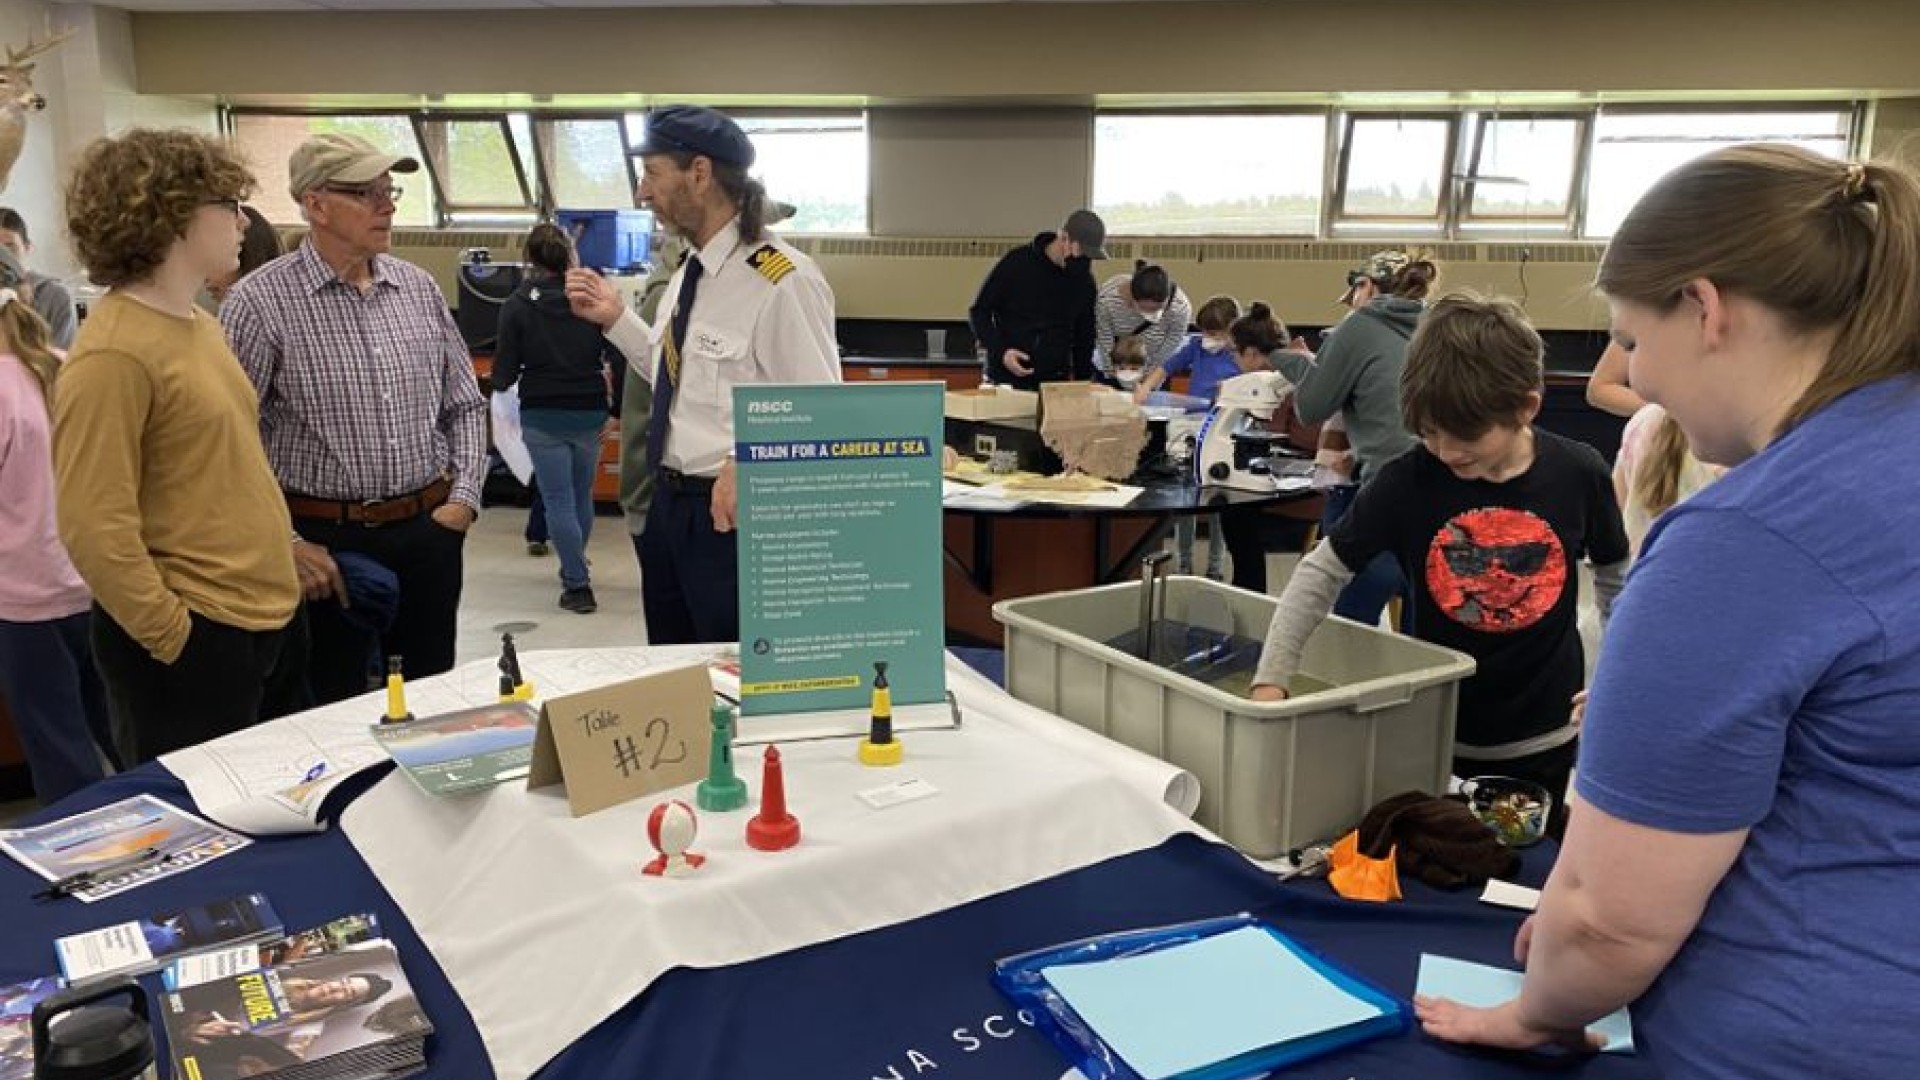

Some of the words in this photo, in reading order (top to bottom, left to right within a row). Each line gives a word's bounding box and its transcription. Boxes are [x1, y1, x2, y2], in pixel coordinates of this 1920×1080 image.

[747, 400, 793, 414] nscc
[750, 445, 789, 459] TRAIN
[791, 443, 816, 458] FOR
[819, 443, 829, 457] A
[831, 441, 880, 456] CAREER
[883, 441, 897, 454] AT
[901, 440, 925, 454] SEA
[576, 708, 620, 738] Table
[613, 717, 687, 777] #2
